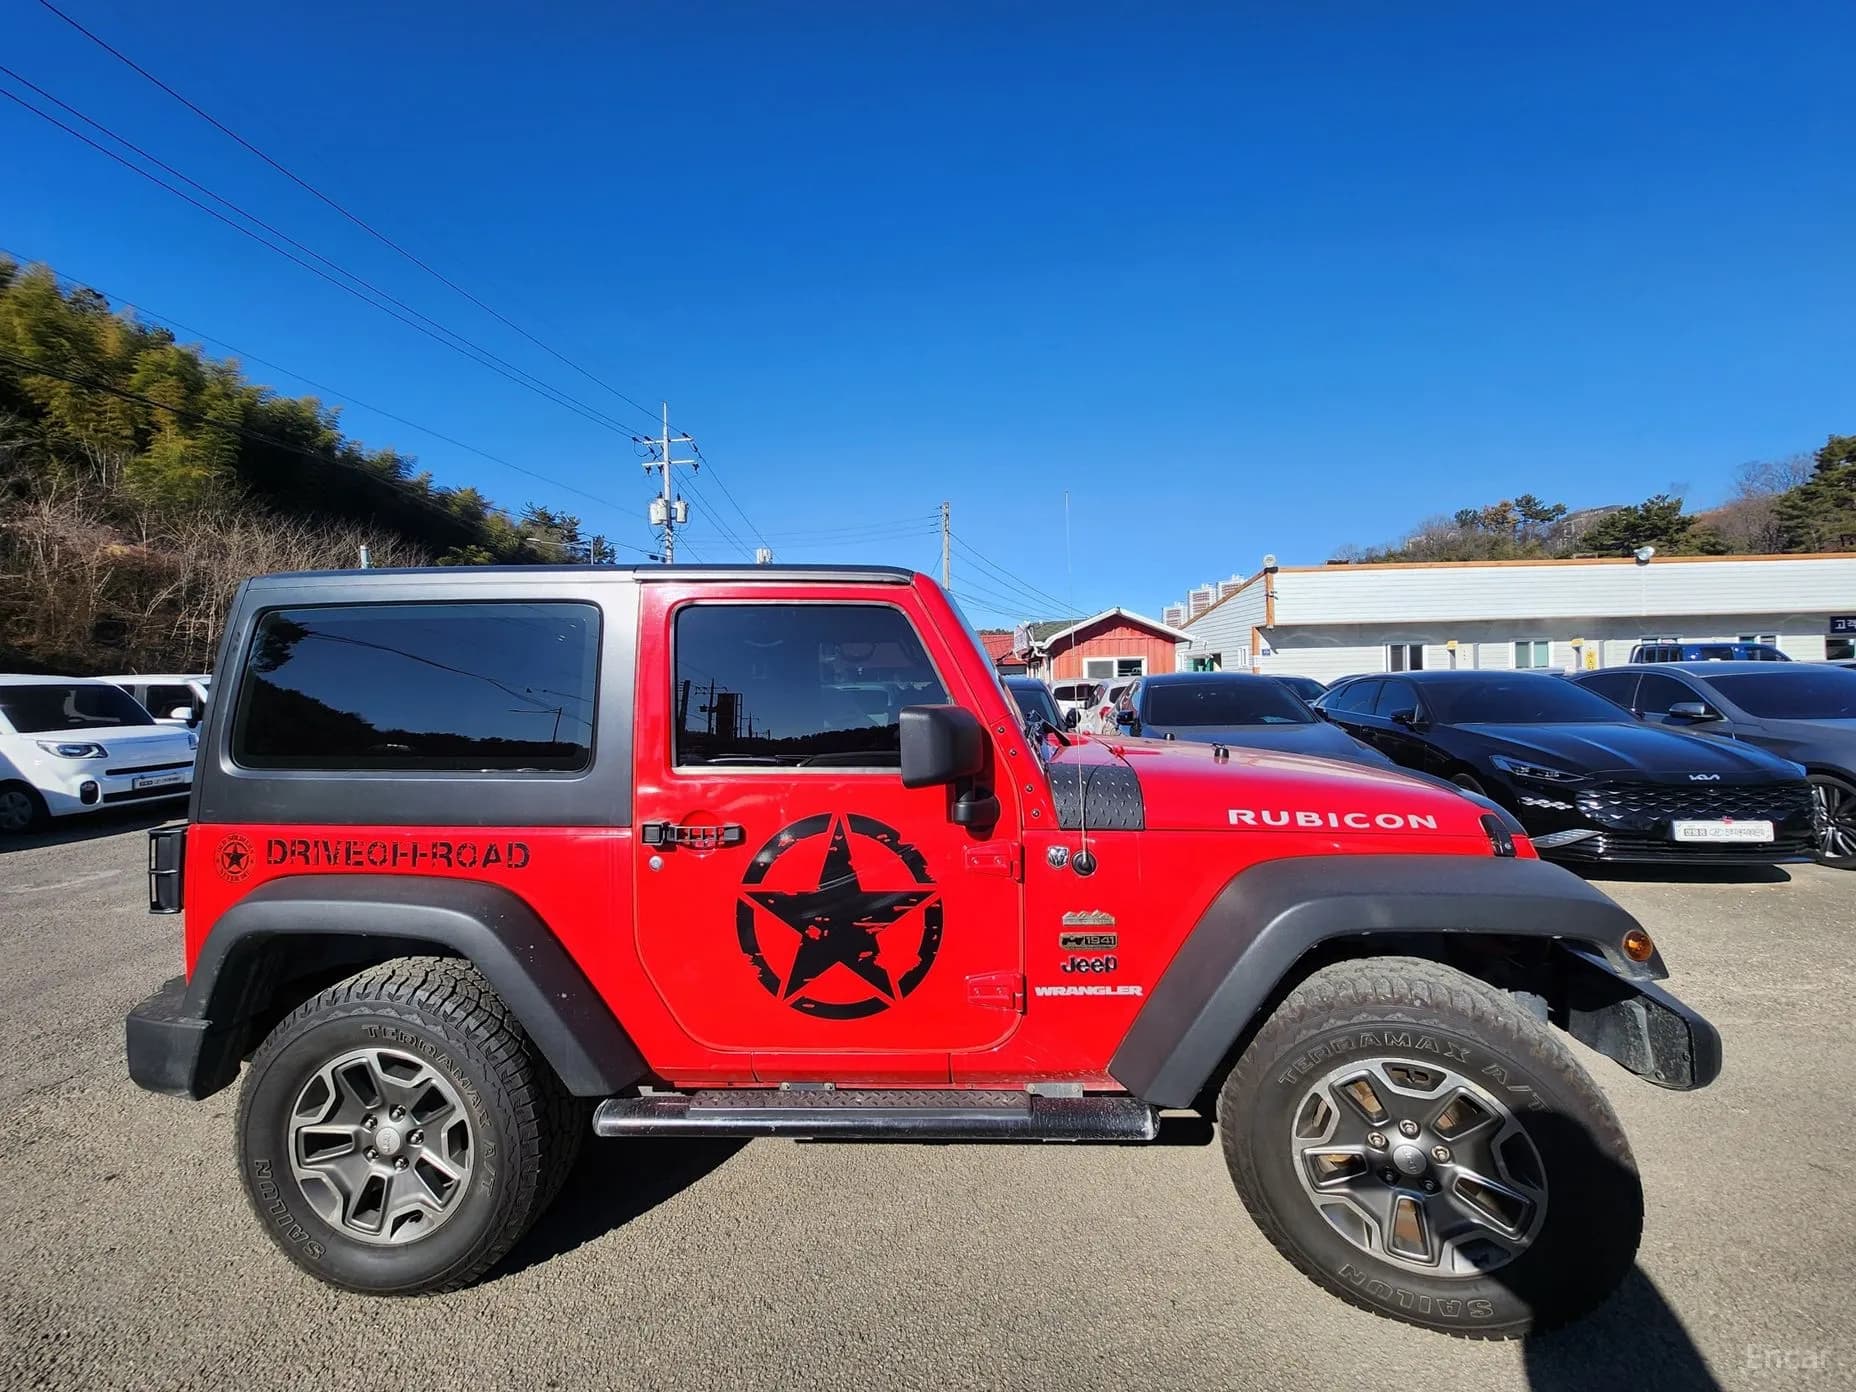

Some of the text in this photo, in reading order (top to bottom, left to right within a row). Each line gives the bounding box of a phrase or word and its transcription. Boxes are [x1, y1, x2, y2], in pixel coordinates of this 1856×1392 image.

[1227, 808, 1438, 830] RUBICON
[1085, 936, 1115, 946] 1941
[1060, 955, 1118, 974] Jeep
[1034, 985, 1143, 998] WRANGLER
[1278, 1031, 1472, 1085] TERRAMAX
[254, 1159, 327, 1261] SAILUN
[1337, 1264, 1495, 1318] SAILUN
